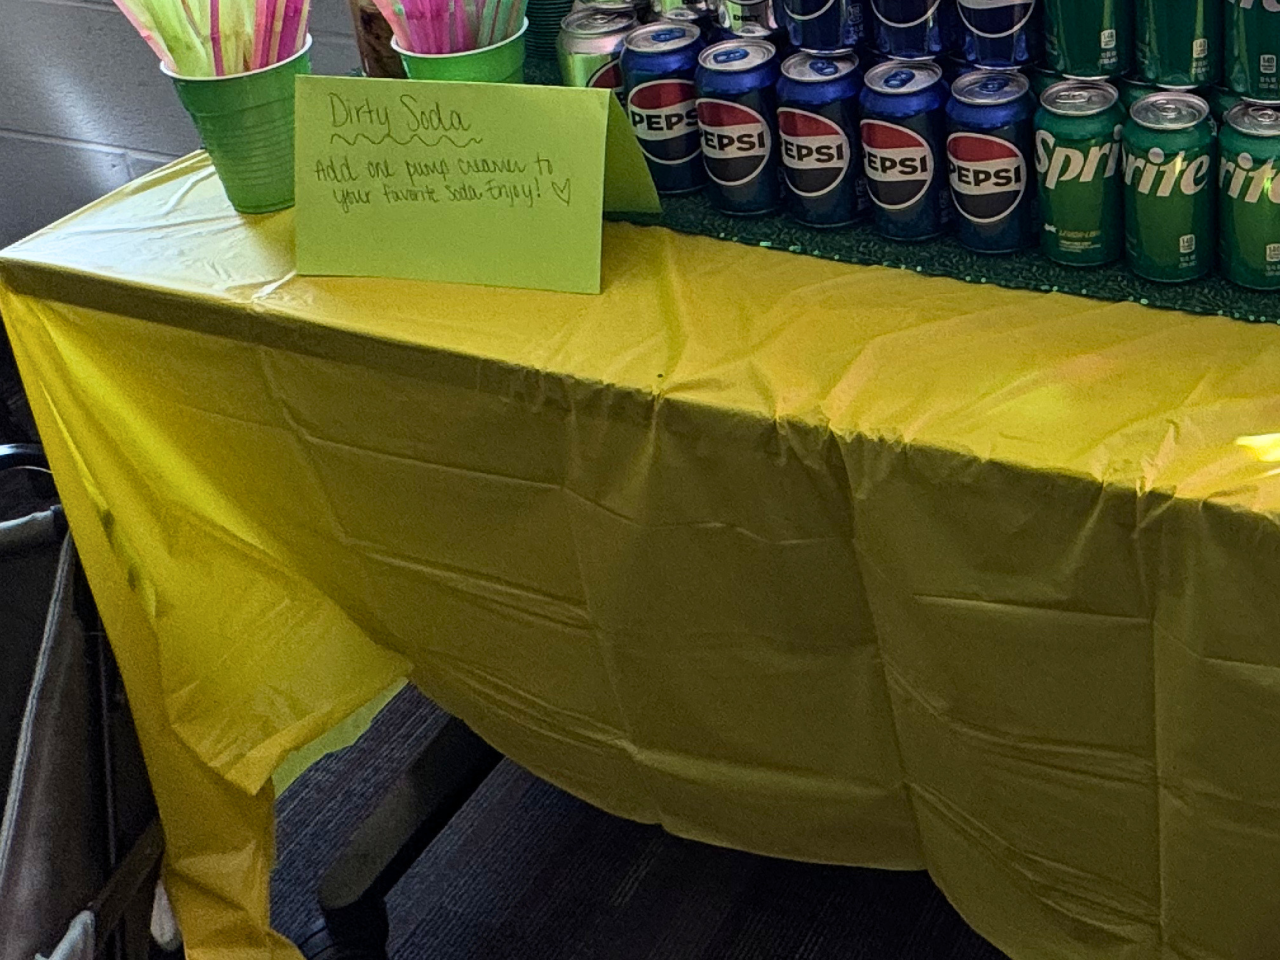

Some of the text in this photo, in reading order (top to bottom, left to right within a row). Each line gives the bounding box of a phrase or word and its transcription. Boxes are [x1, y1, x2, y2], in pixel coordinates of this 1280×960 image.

[328, 91, 472, 136] Dirty Soda
[632, 110, 698, 132] PEPS
[700, 130, 765, 152] EPSI
[782, 138, 844, 164] EPSI
[1034, 124, 1123, 190] Spri
[314, 151, 554, 187] Add one pump creamer to
[865, 150, 928, 176] EPSI
[1121, 145, 1210, 198] rite
[332, 187, 371, 214] your
[485, 176, 541, 208] Enjoy!
